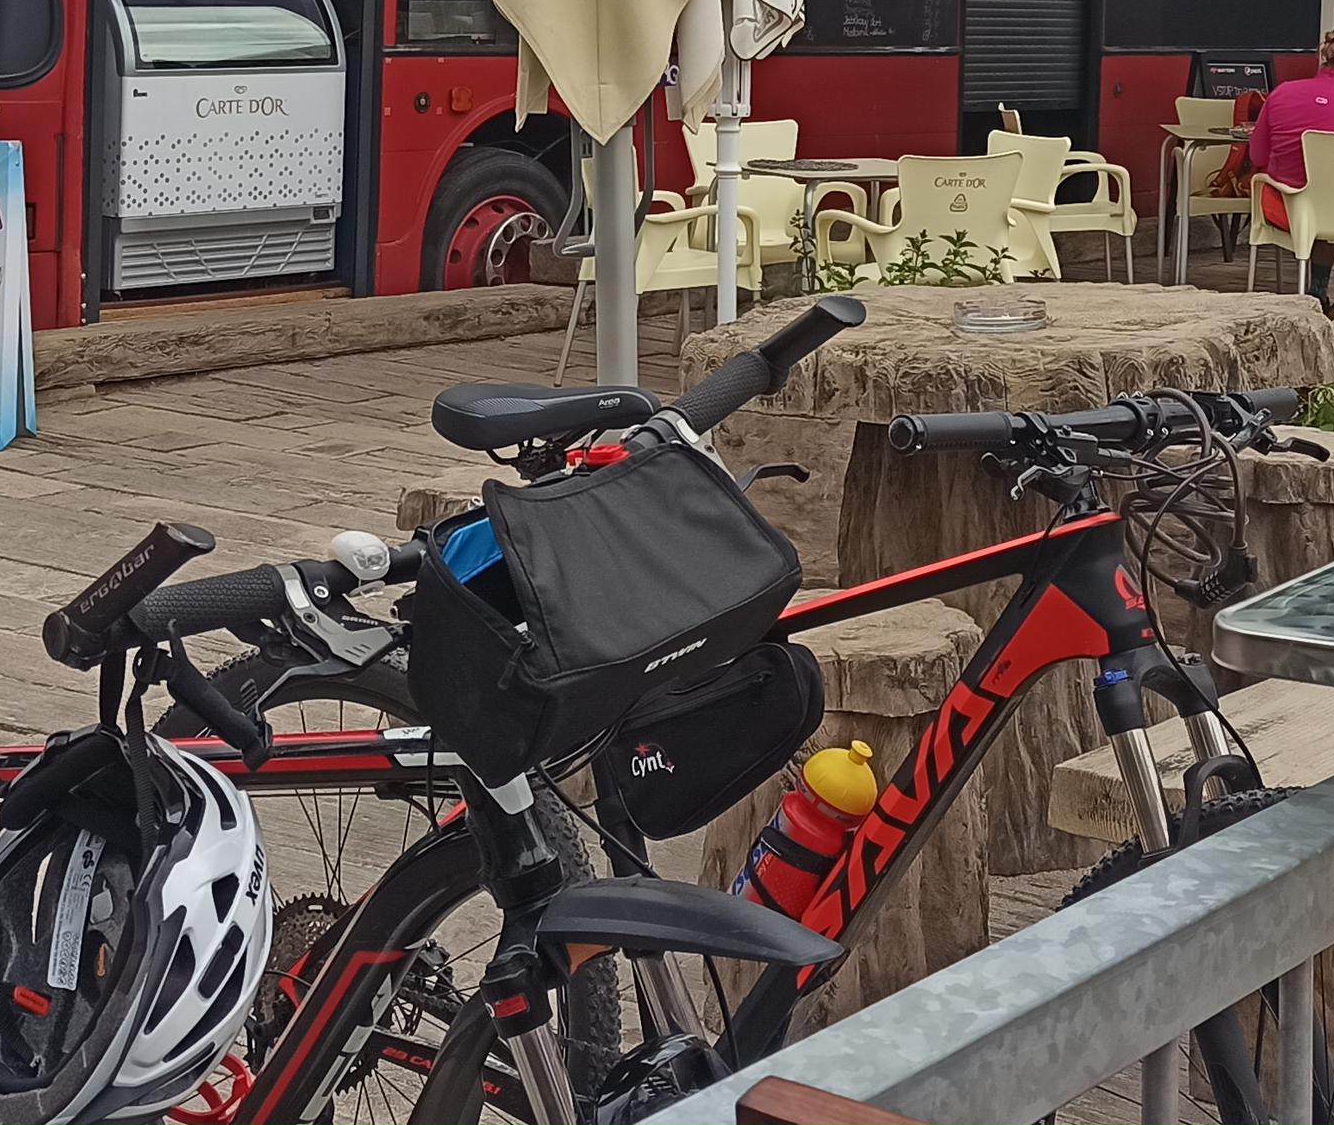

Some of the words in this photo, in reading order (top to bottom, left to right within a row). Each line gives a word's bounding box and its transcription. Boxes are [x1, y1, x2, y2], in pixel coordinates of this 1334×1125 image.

[196, 97, 244, 118] CARTE
[249, 96, 289, 116] D'OR
[934, 176, 966, 189] CARTE
